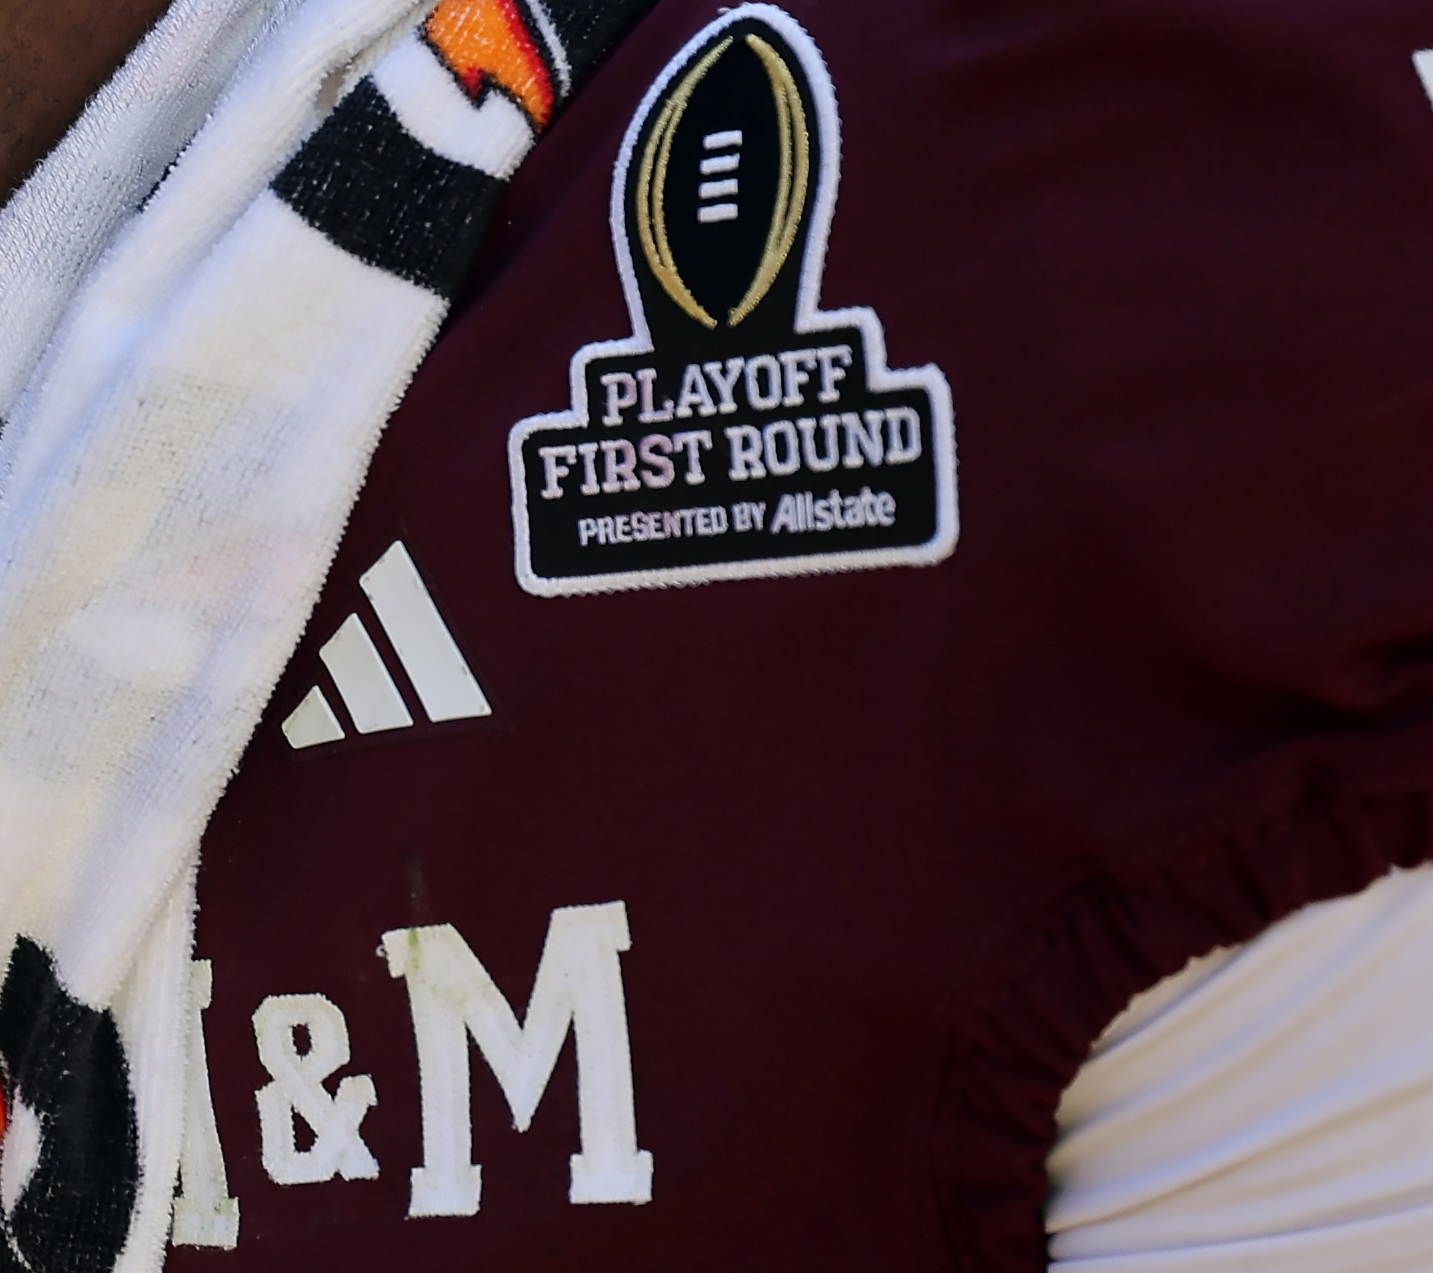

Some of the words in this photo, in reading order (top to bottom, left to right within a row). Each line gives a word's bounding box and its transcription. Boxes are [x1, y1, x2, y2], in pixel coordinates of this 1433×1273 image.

[600, 345, 853, 426] PLAYOFF
[538, 427, 714, 501] FIRST
[726, 407, 922, 483] ROUND
[578, 506, 728, 547] PRESENTED
[732, 501, 767, 533] BY
[772, 486, 897, 535] Allstate
[170, 901, 656, 1249] &M
